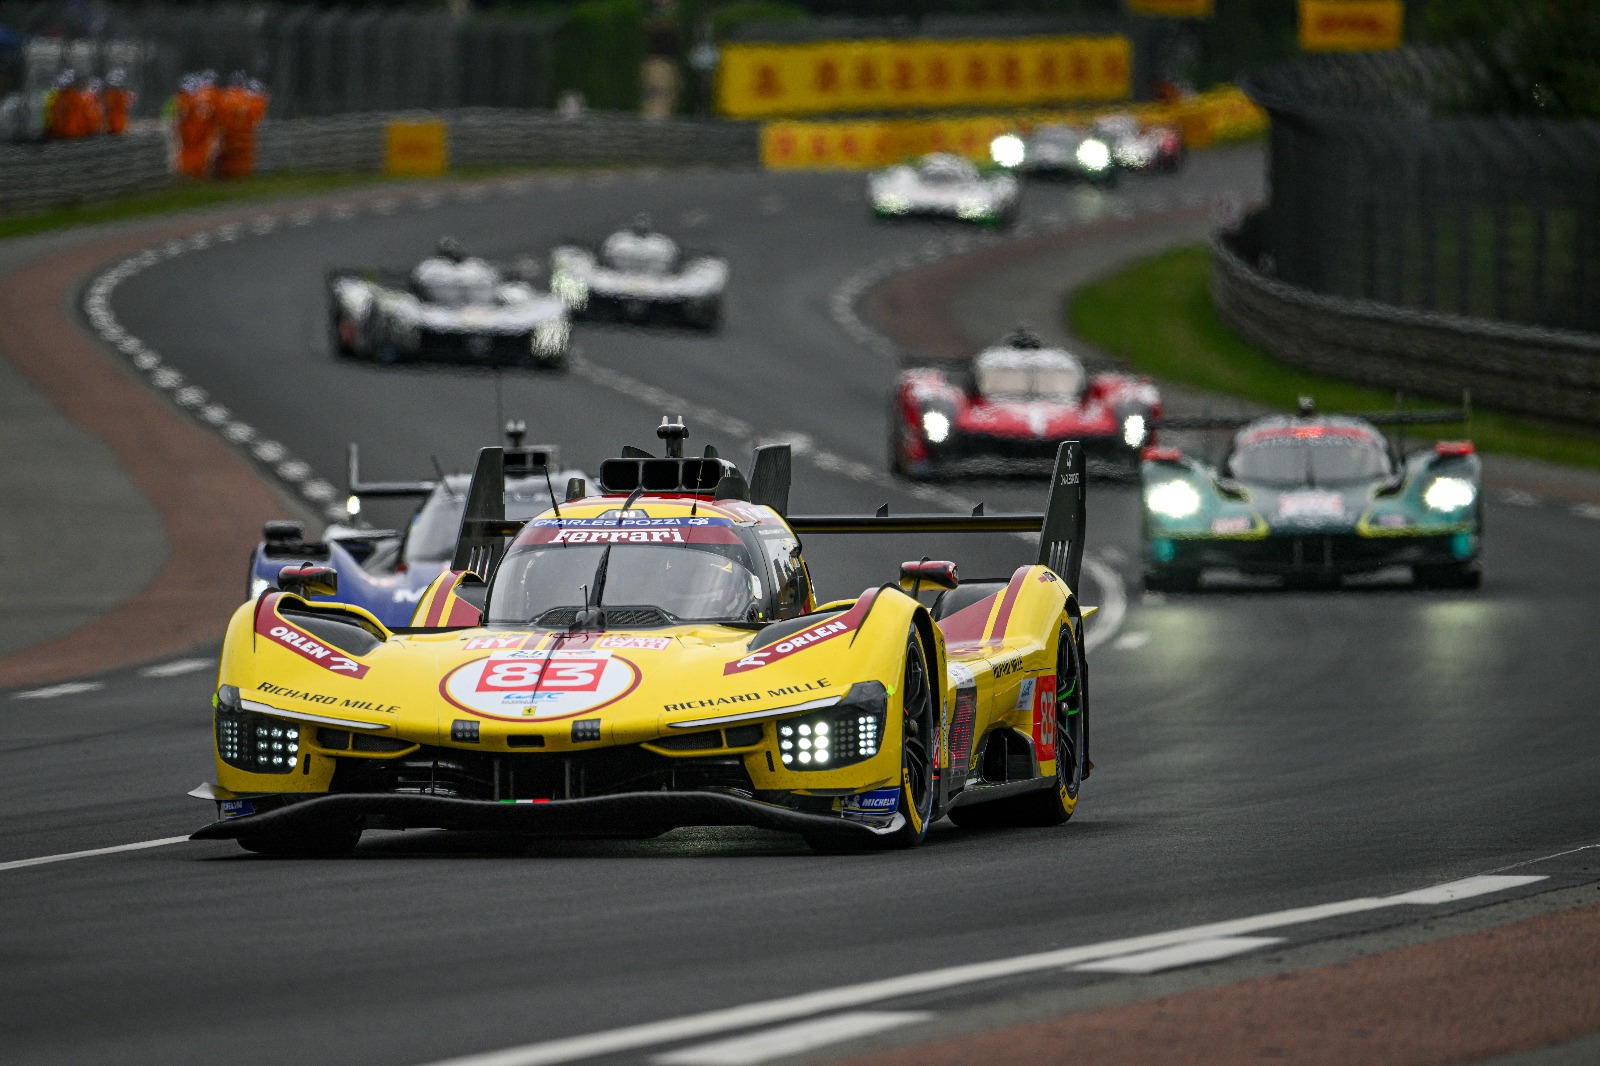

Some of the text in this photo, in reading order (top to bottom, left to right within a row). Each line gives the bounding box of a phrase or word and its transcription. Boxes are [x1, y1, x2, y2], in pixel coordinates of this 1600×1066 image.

[534, 519, 617, 527] CHARLES
[548, 528, 685, 543] Ferrari
[269, 626, 330, 659] ORLEN
[775, 621, 848, 653] ORLEN
[485, 662, 599, 687] 83
[257, 681, 401, 714] RICHARD MILLE
[663, 677, 832, 712] RICHARD MILLE
[1041, 691, 1054, 745] 83
